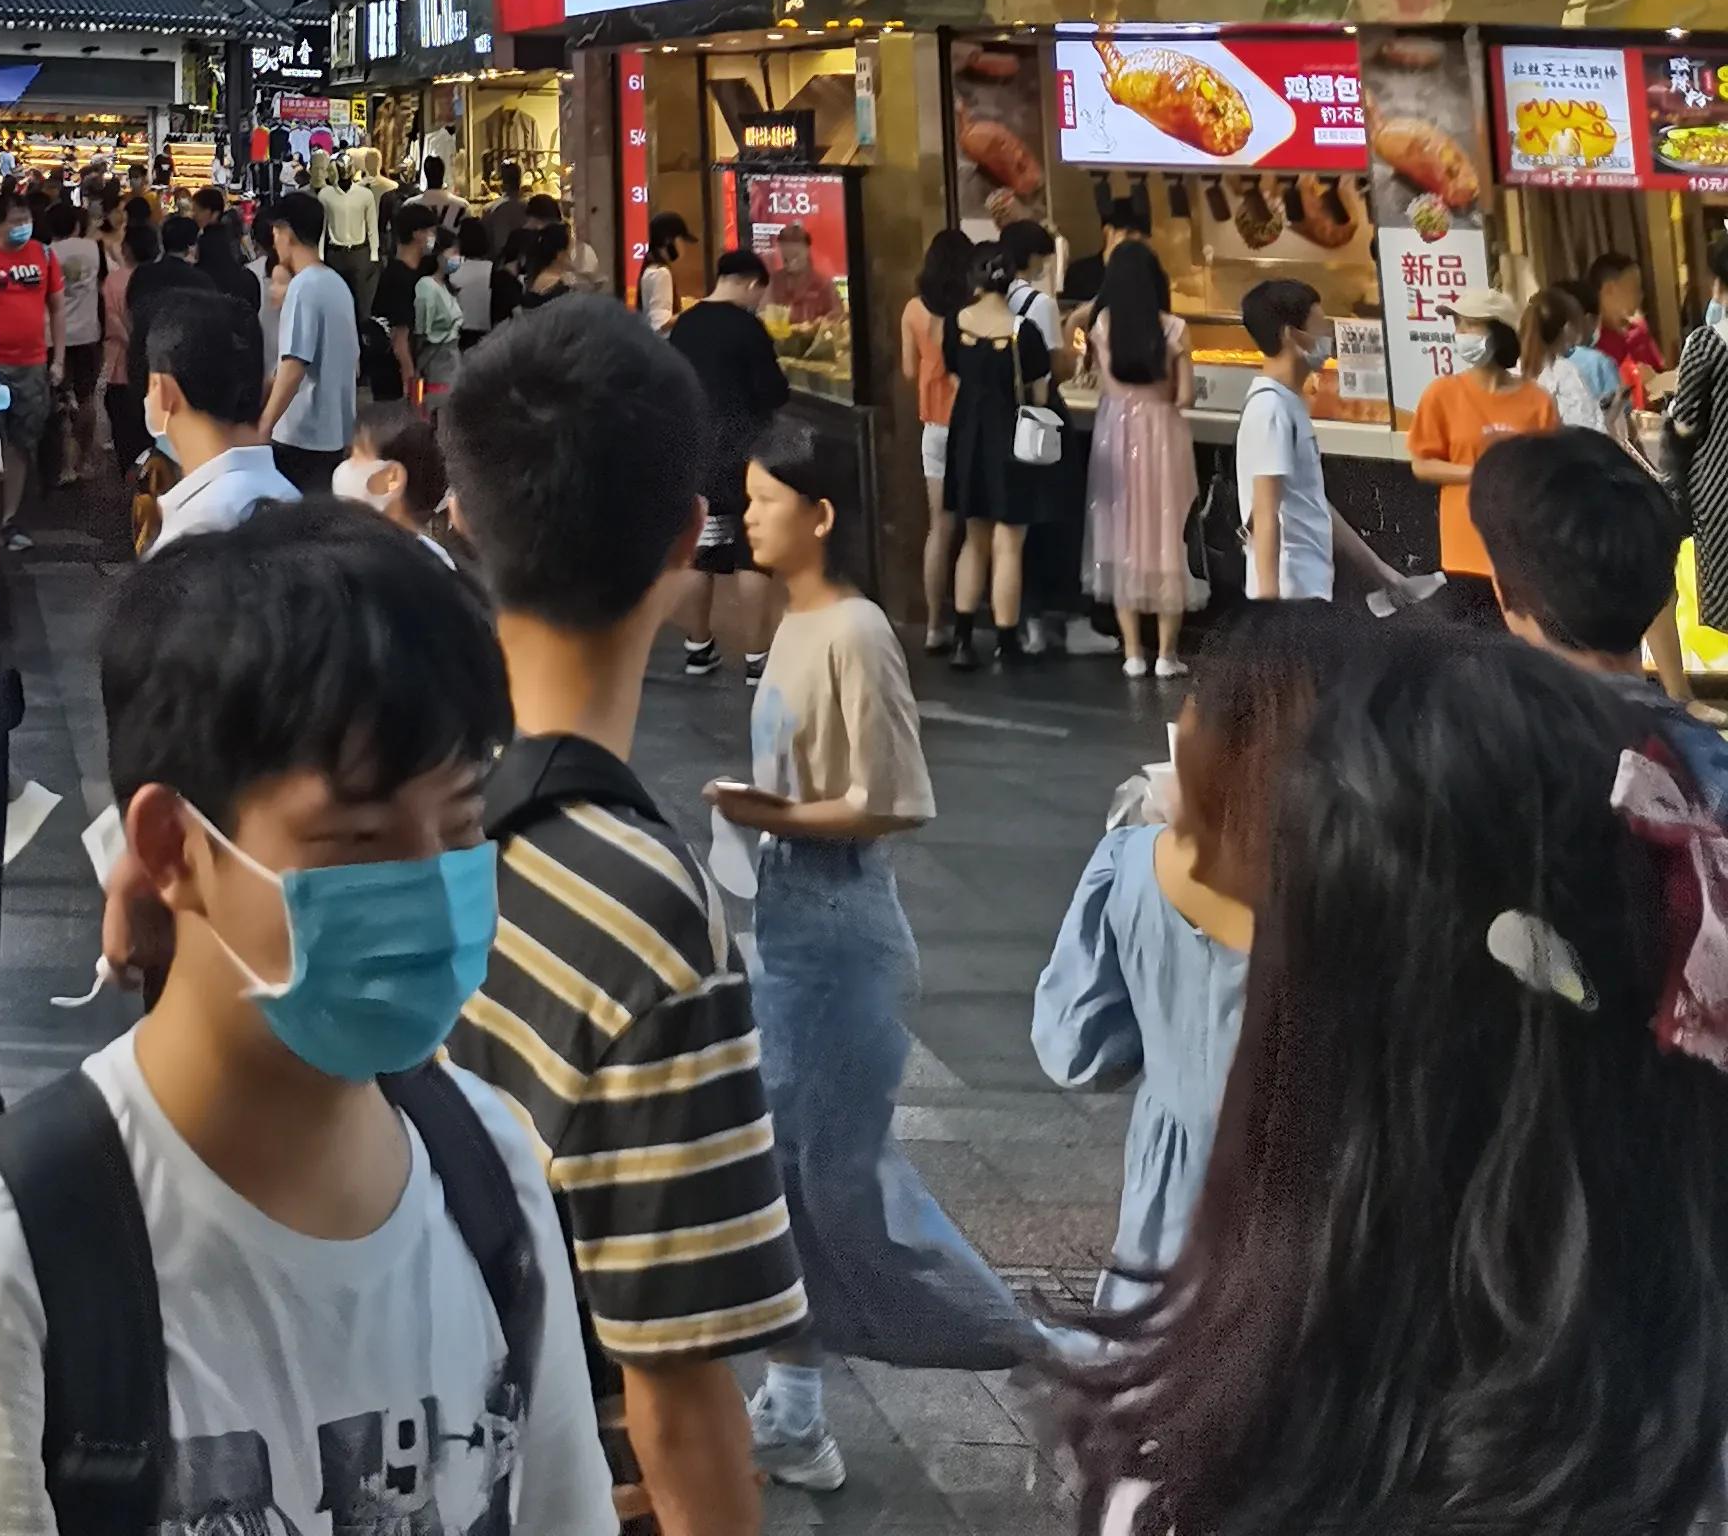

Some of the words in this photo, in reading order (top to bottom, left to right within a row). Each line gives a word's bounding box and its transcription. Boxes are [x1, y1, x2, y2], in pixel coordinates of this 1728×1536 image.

[1284, 74, 1361, 104] 鸡翅包
[1400, 251, 1467, 288] 新品
[1427, 345, 1454, 376] 13
